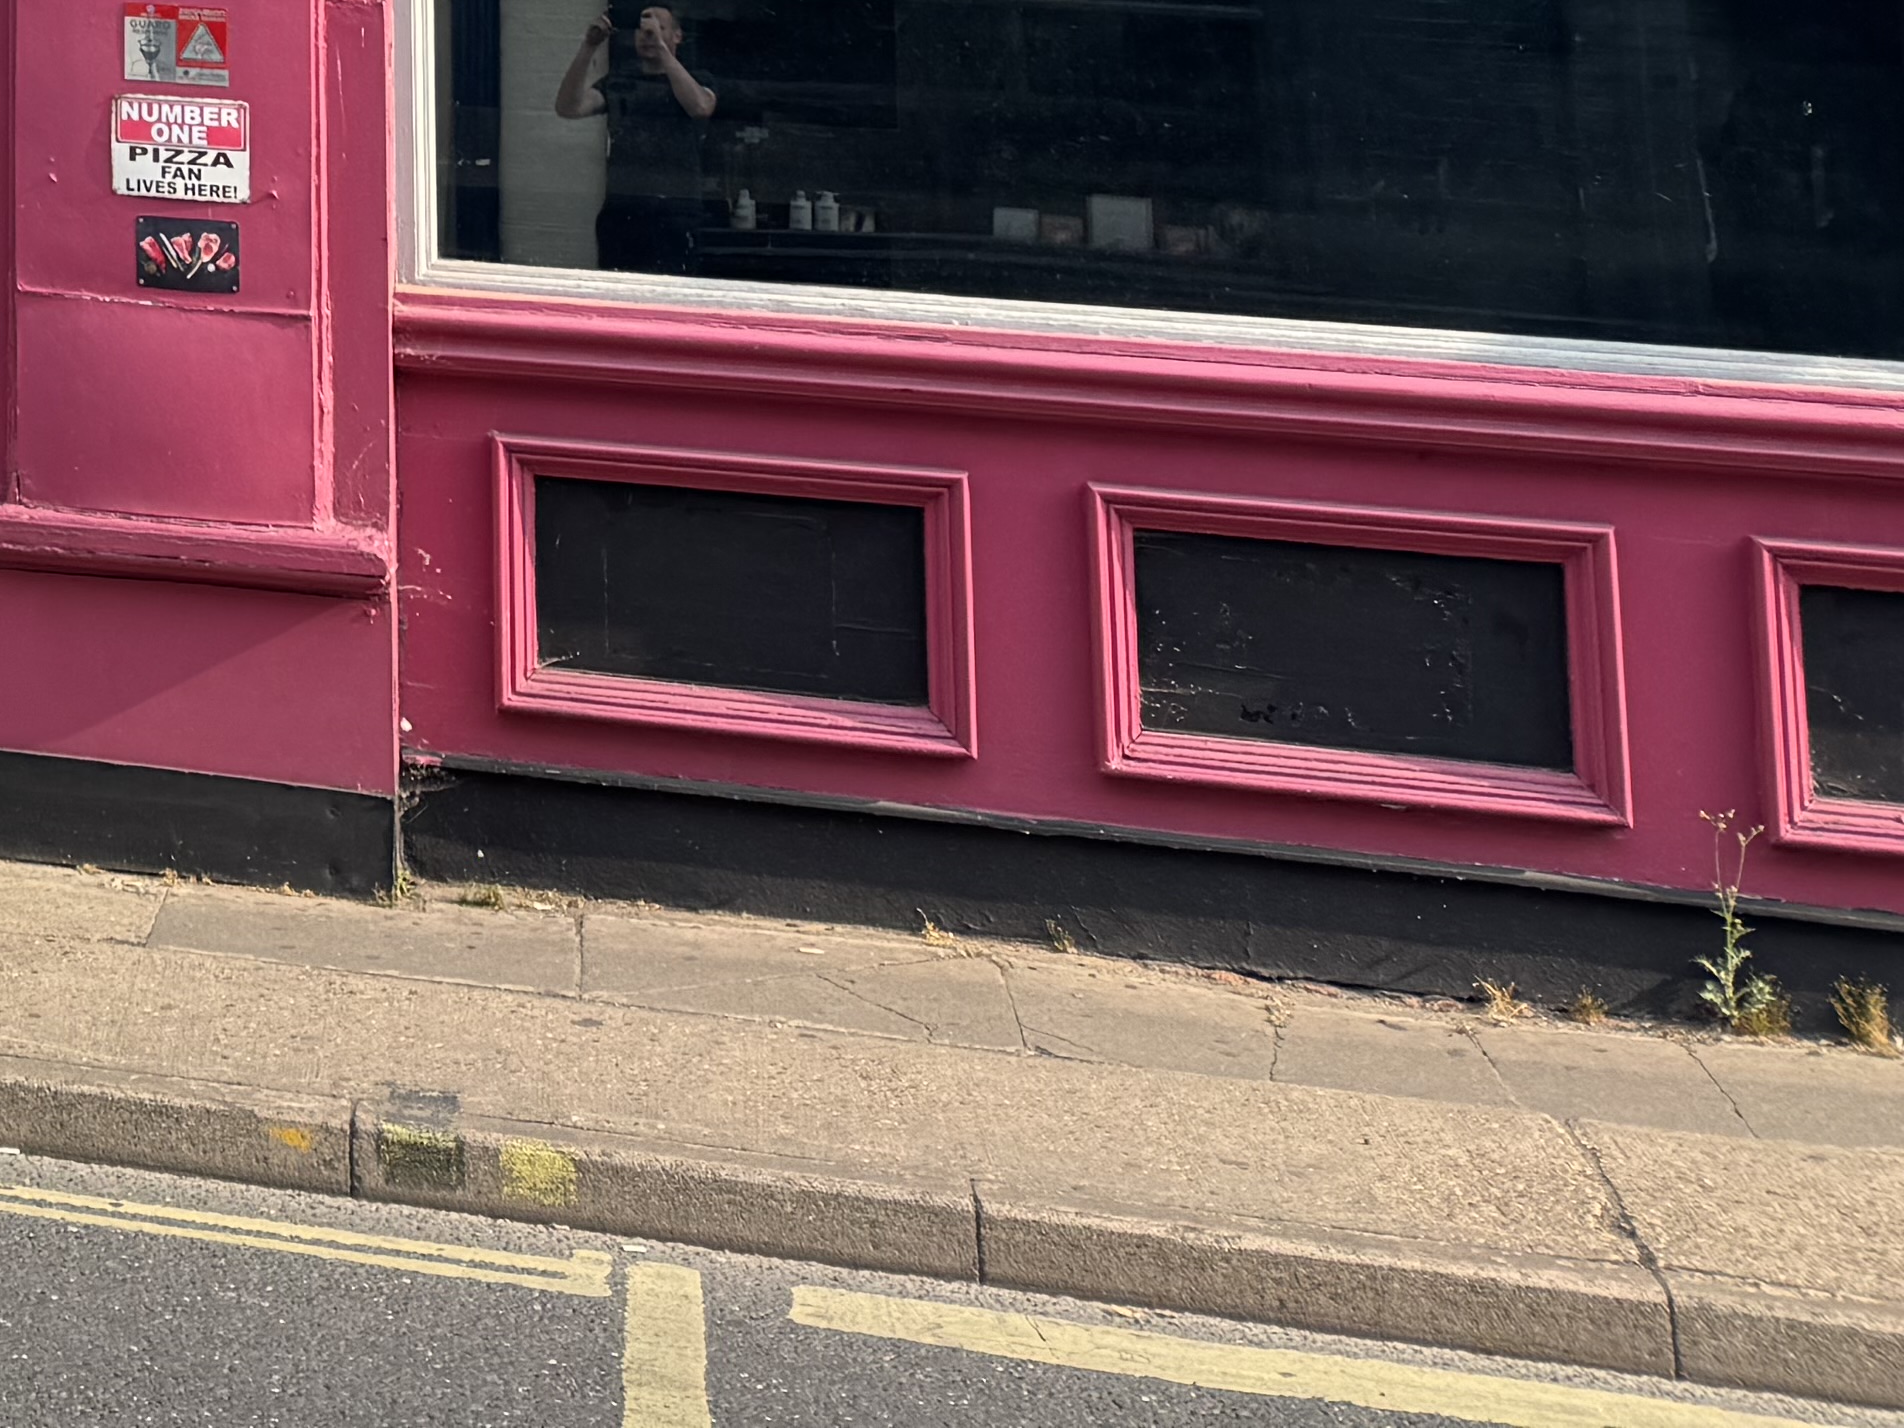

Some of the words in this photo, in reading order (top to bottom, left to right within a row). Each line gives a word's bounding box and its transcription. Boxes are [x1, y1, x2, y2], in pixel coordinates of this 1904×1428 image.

[130, 19, 171, 30] GUARD
[121, 100, 240, 128] NUMBER
[151, 122, 208, 146] ONE
[129, 145, 235, 168] PIZZA
[161, 165, 202, 182] FAN
[126, 178, 178, 195] LIVES
[184, 182, 238, 199] HERE!
